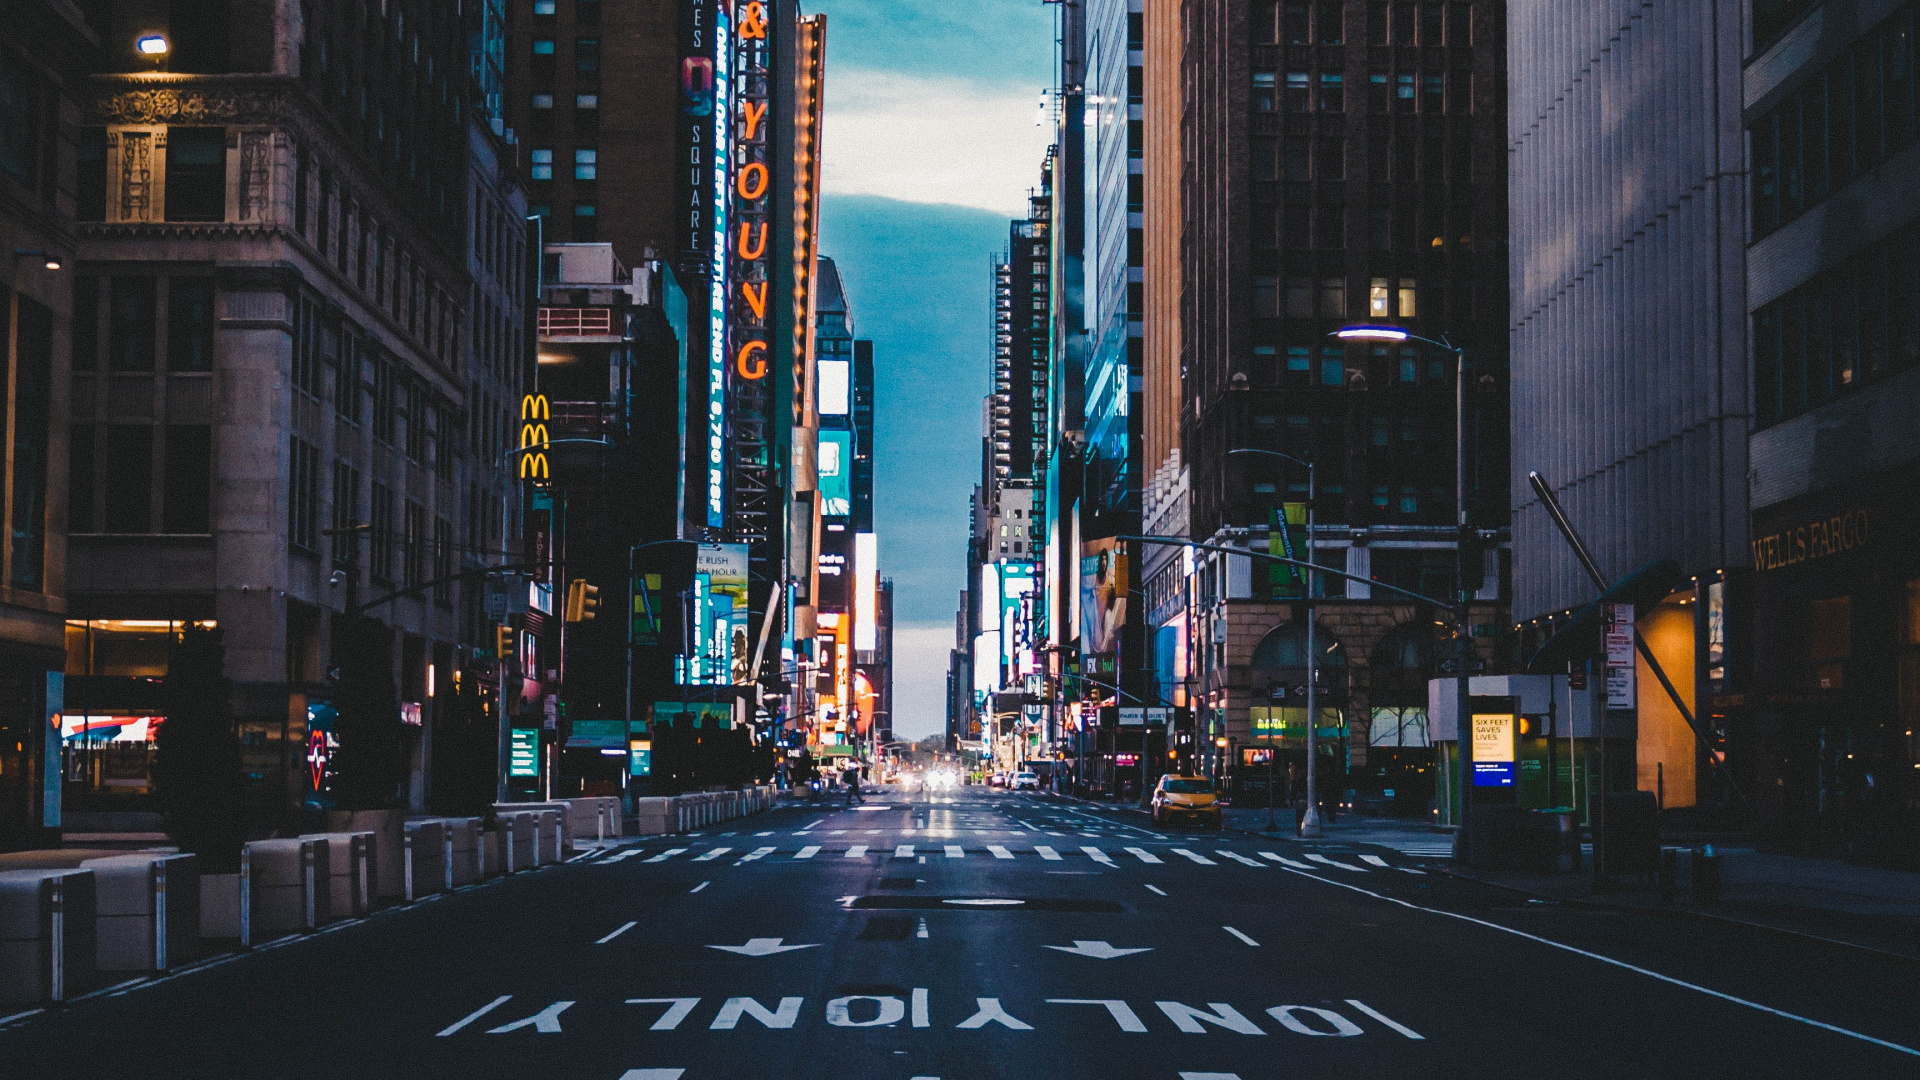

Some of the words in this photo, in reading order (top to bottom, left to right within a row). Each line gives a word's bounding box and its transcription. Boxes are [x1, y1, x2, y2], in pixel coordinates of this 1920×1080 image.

[738, 1, 769, 39] &
[716, 26, 727, 76] ONE
[715, 77, 727, 151] FLOOR
[690, 125, 701, 250] SQUARE
[714, 155, 726, 212] LEFT
[737, 102, 770, 380] YOUNG
[712, 230, 725, 313] ENTIRE
[711, 316, 723, 364] 2ND
[711, 368, 723, 395] FL
[705, 556, 729, 565] RUSH
[1751, 525, 1806, 572] WELLS
[1809, 508, 1869, 559] FARGO
[711, 567, 737, 576] HOUR
[1087, 657, 1098, 674] FX
[484, 996, 906, 1035] ONLY
[955, 997, 1367, 1037] ONLY
